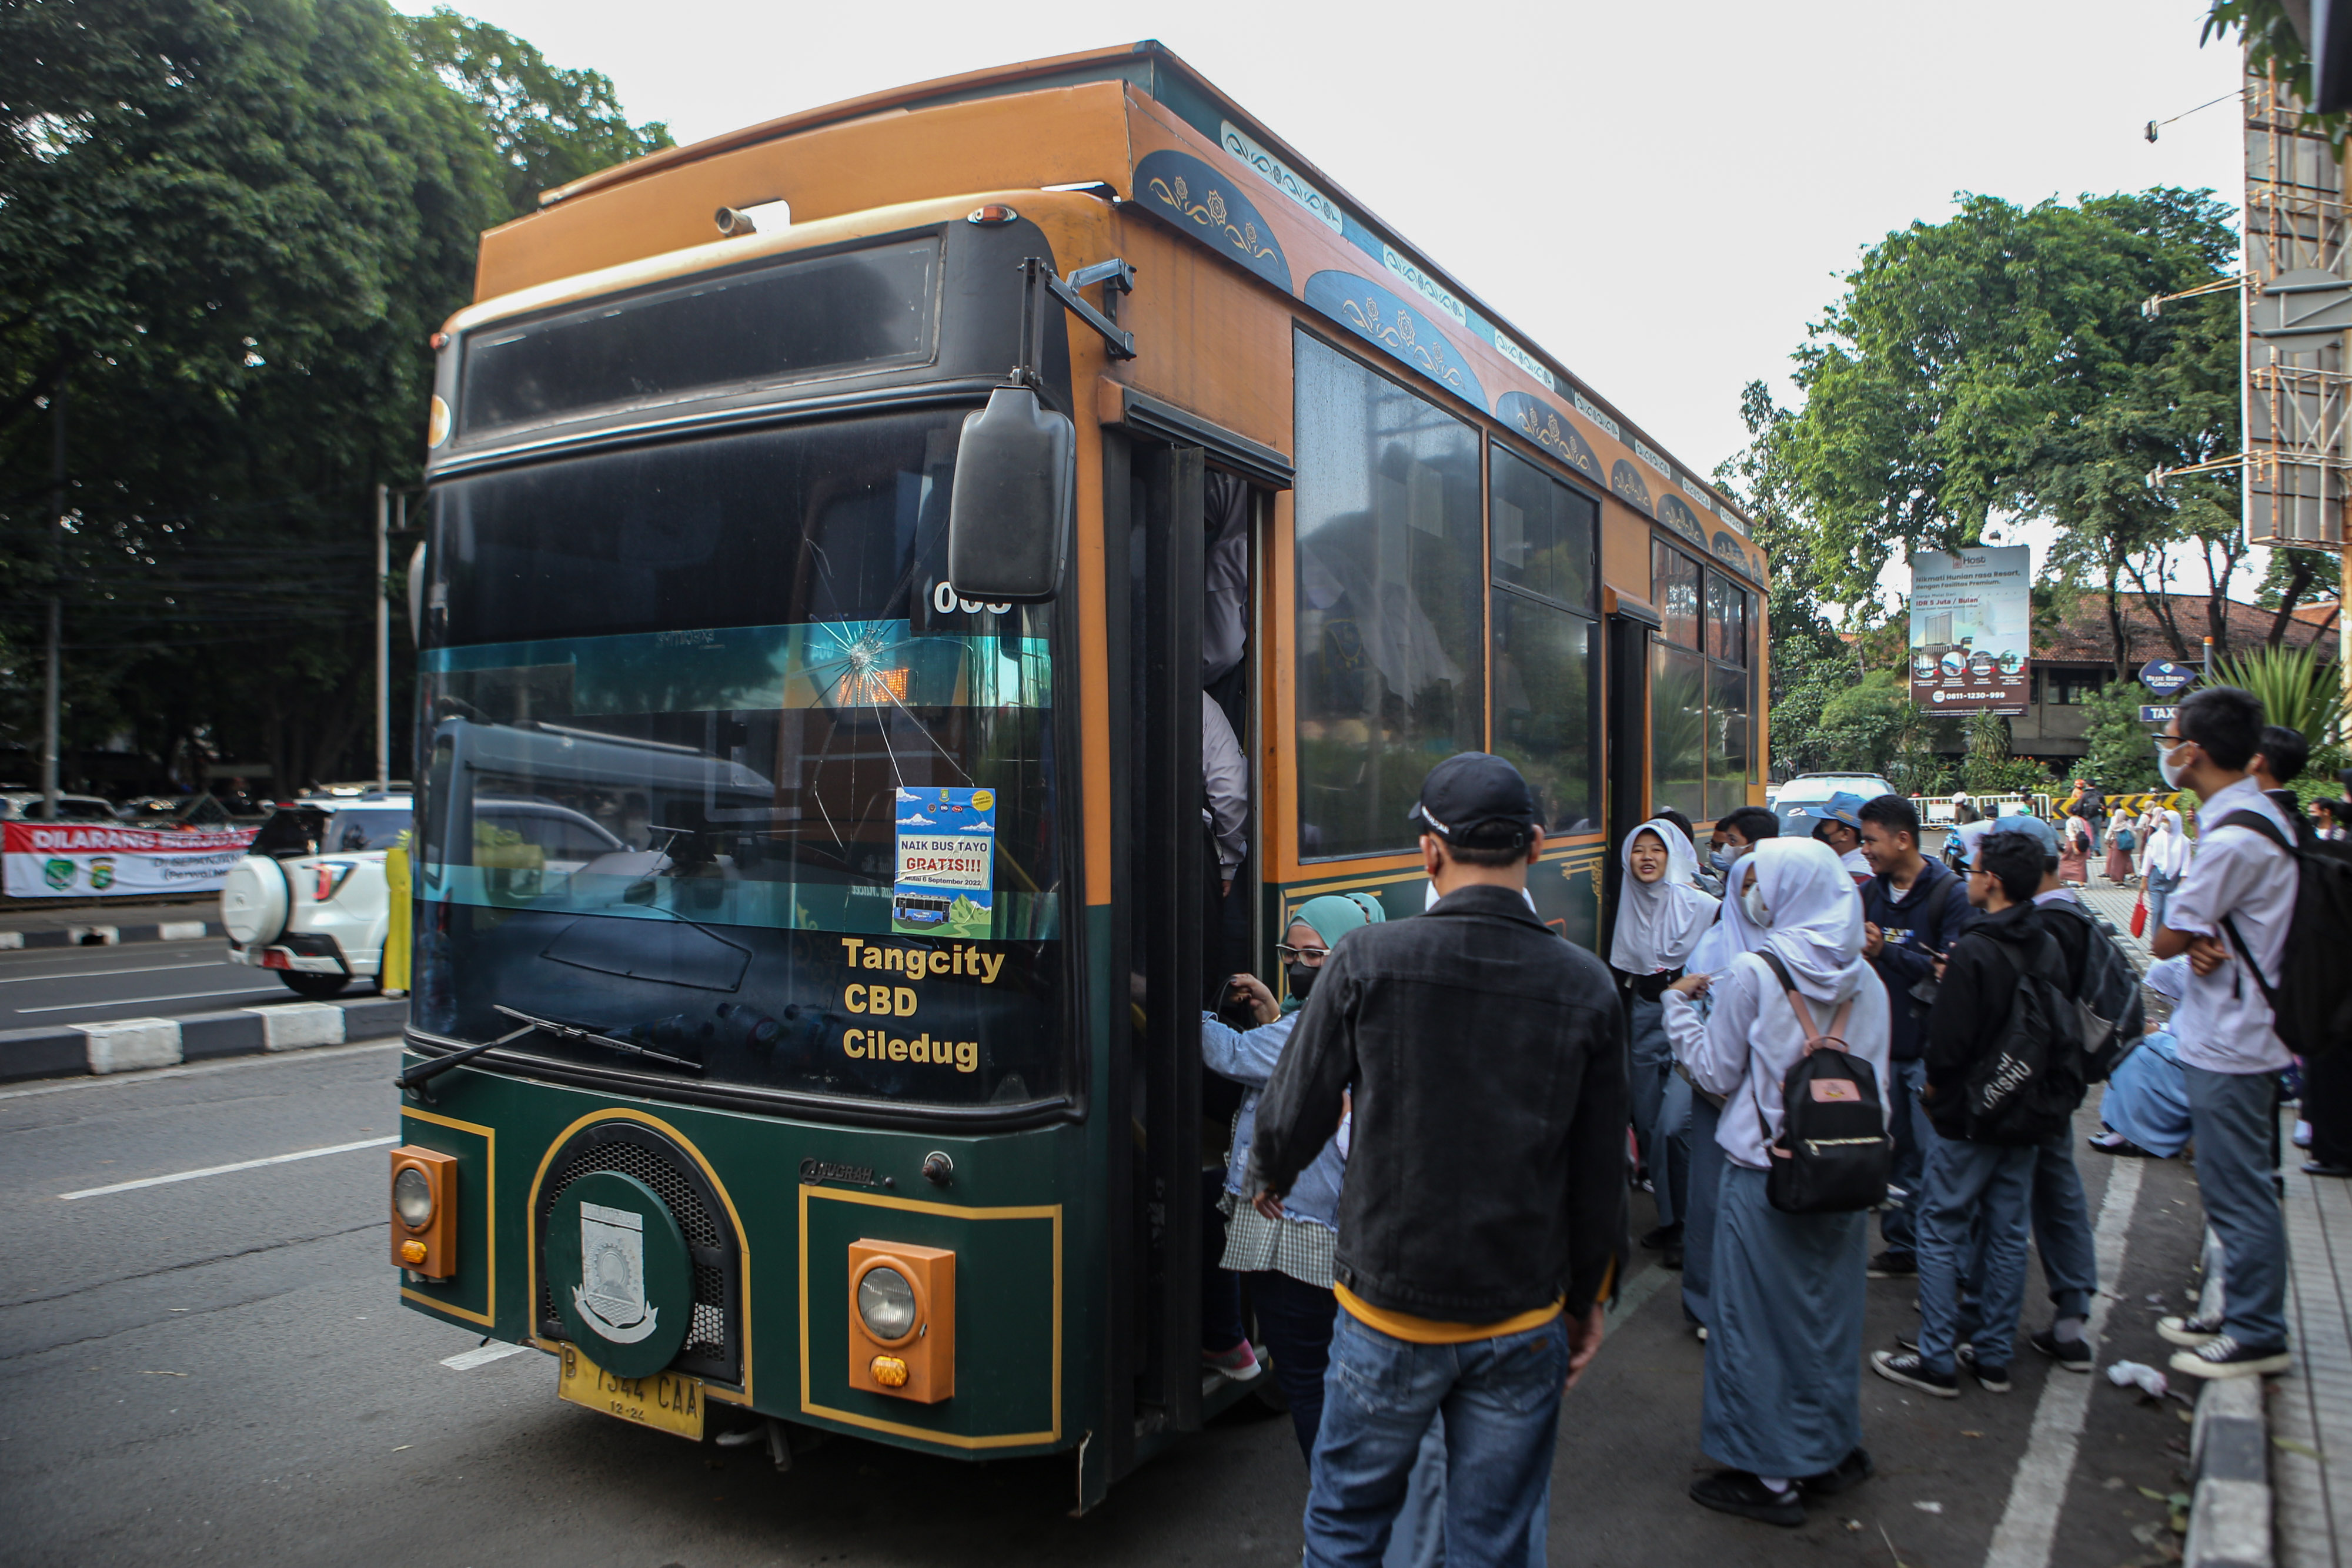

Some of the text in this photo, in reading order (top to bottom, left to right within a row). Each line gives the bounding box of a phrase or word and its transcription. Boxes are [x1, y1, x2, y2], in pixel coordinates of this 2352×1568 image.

[1916, 574, 1945, 583] Nikmati
[1946, 573, 1974, 581] Hunian
[1993, 570, 2020, 578] Resort,
[32, 829, 156, 849] DILARANG
[901, 841, 988, 852] NAIK BUS TAYO
[907, 857, 981, 872] GRATIS!!!
[928, 877, 963, 885] September
[841, 938, 1005, 984] Tangcity
[844, 983, 917, 1017] CBD
[843, 1028, 978, 1073] Ciledug
[566, 1345, 576, 1379] B
[659, 1376, 698, 1419] CAA
